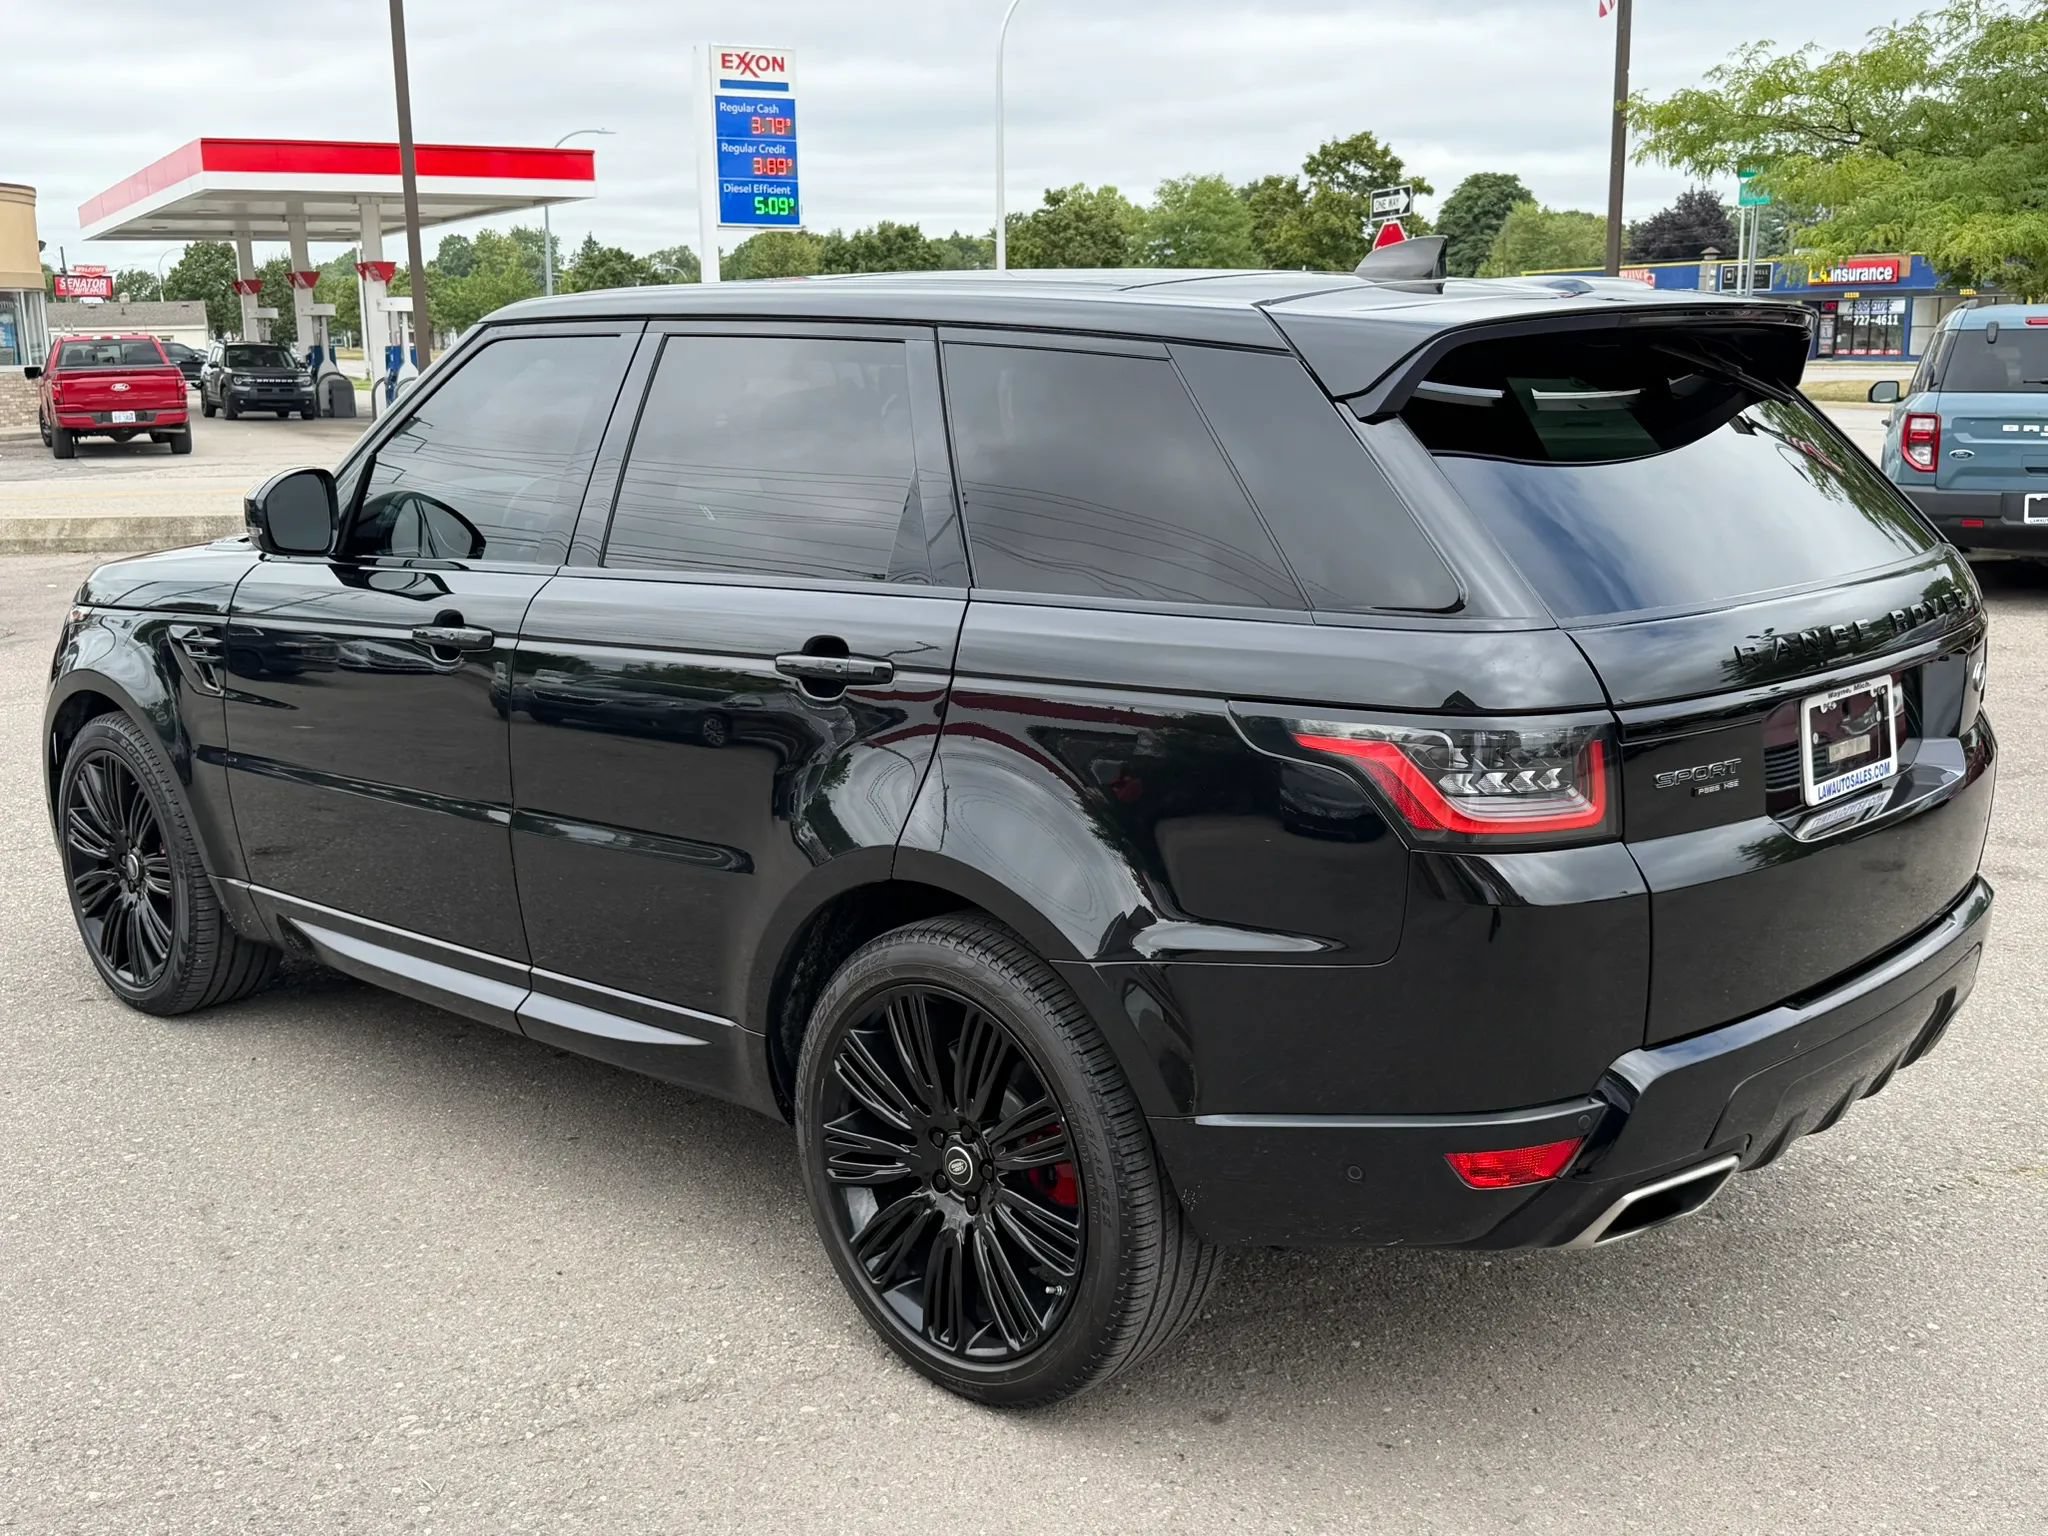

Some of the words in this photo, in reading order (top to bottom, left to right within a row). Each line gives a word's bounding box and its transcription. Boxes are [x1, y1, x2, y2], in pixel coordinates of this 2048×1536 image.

[721, 51, 785, 78] EXXON
[720, 102, 755, 114] Regular
[757, 103, 779, 114] Cash
[721, 143, 757, 154] Regular
[759, 144, 786, 154] Credit
[723, 183, 752, 194] Diesel
[753, 184, 791, 195] Efficient
[59, 278, 107, 290] SENATOR
[1853, 315, 1899, 326] 727-4611
[1733, 618, 1872, 666] RANGE
[1888, 588, 1970, 633] ROVER
[1827, 687, 1852, 699] Wayne,
[1853, 681, 1872, 691] Mich.
[1654, 758, 1742, 788] SPORT
[1817, 761, 1891, 800] LAWAUTOSALES.COM
